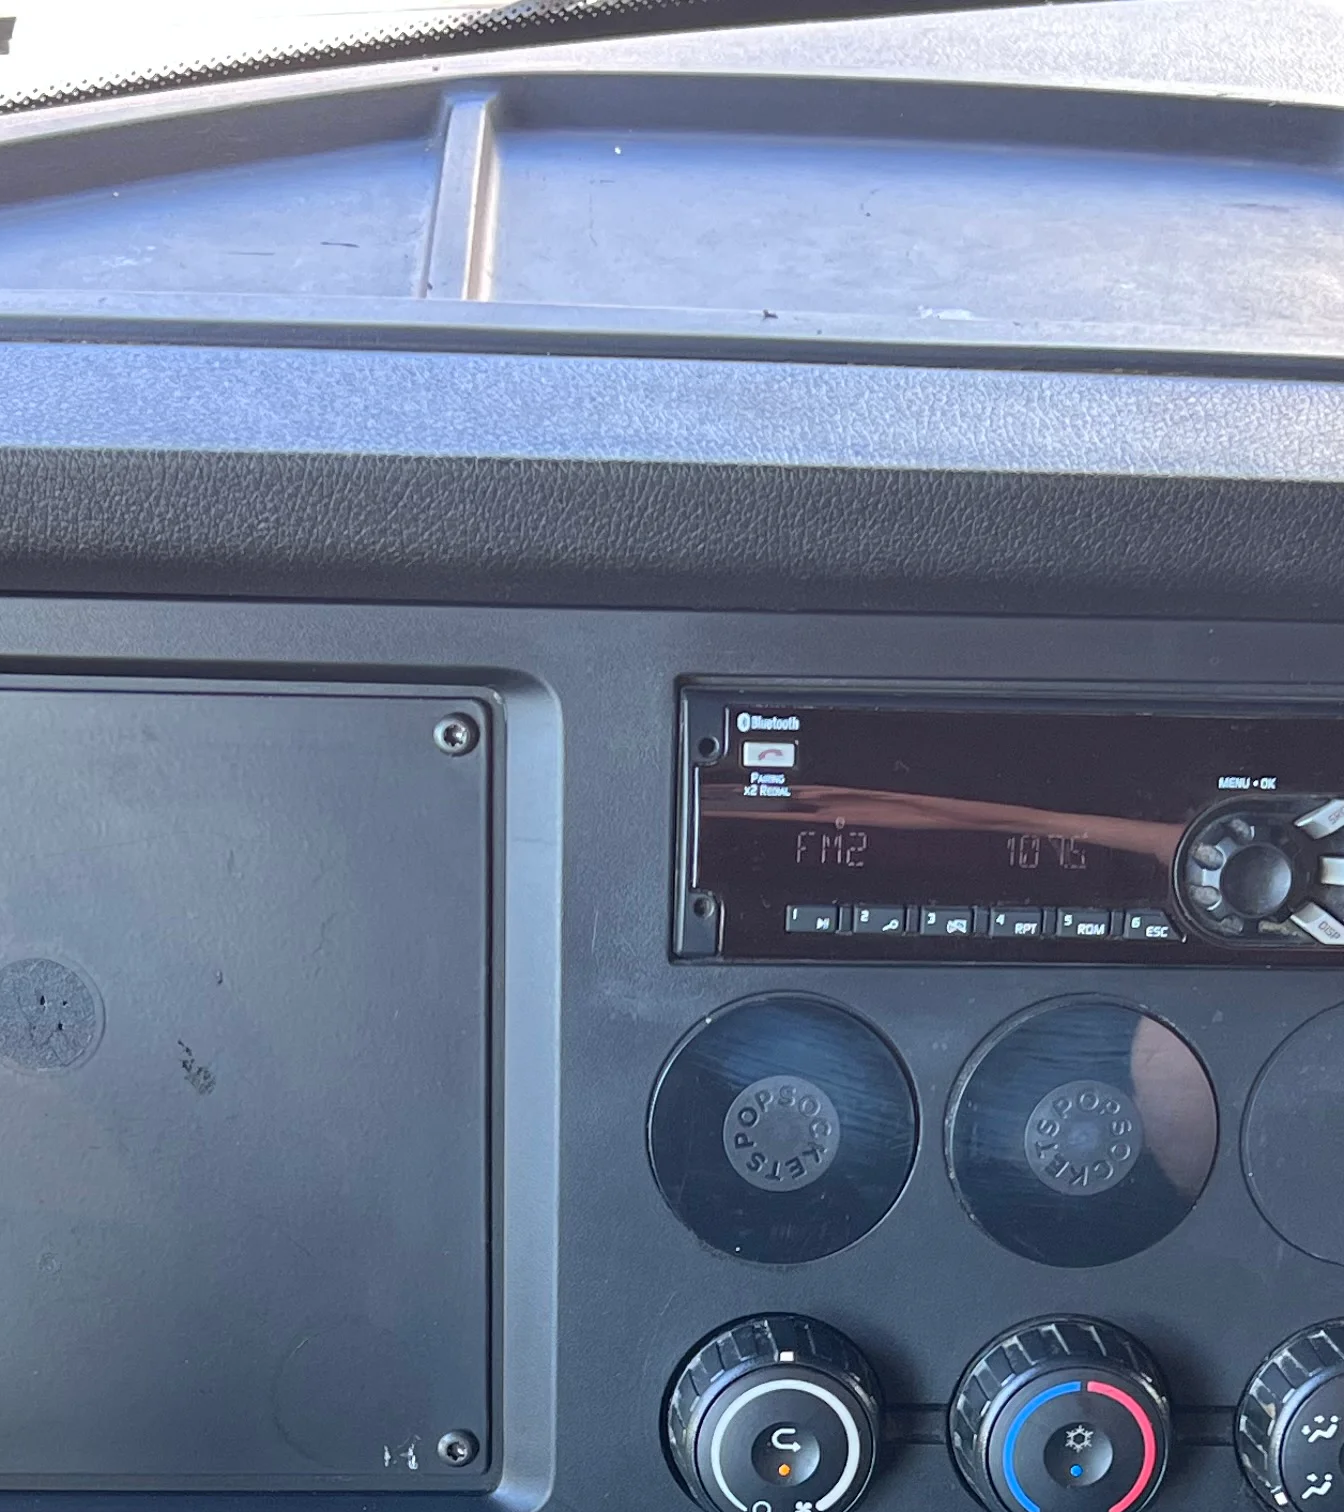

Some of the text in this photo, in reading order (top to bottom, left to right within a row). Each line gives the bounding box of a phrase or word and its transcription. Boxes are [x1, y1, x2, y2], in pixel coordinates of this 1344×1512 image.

[751, 715, 800, 731] Bluetooth
[1218, 777, 1277, 790] MENU OK
[796, 832, 868, 867] FM2
[792, 908, 798, 920] 1
[860, 910, 869, 922] 2
[927, 912, 936, 924] 3
[996, 913, 1005, 926] 4
[1064, 914, 1072, 926] 5
[1014, 922, 1038, 936] RPT
[1131, 917, 1140, 928] 6
[1146, 926, 1168, 938] ESC
[1317, 921, 1342, 940] DISP
[734, 1085, 832, 1181] POPSOCKETS
